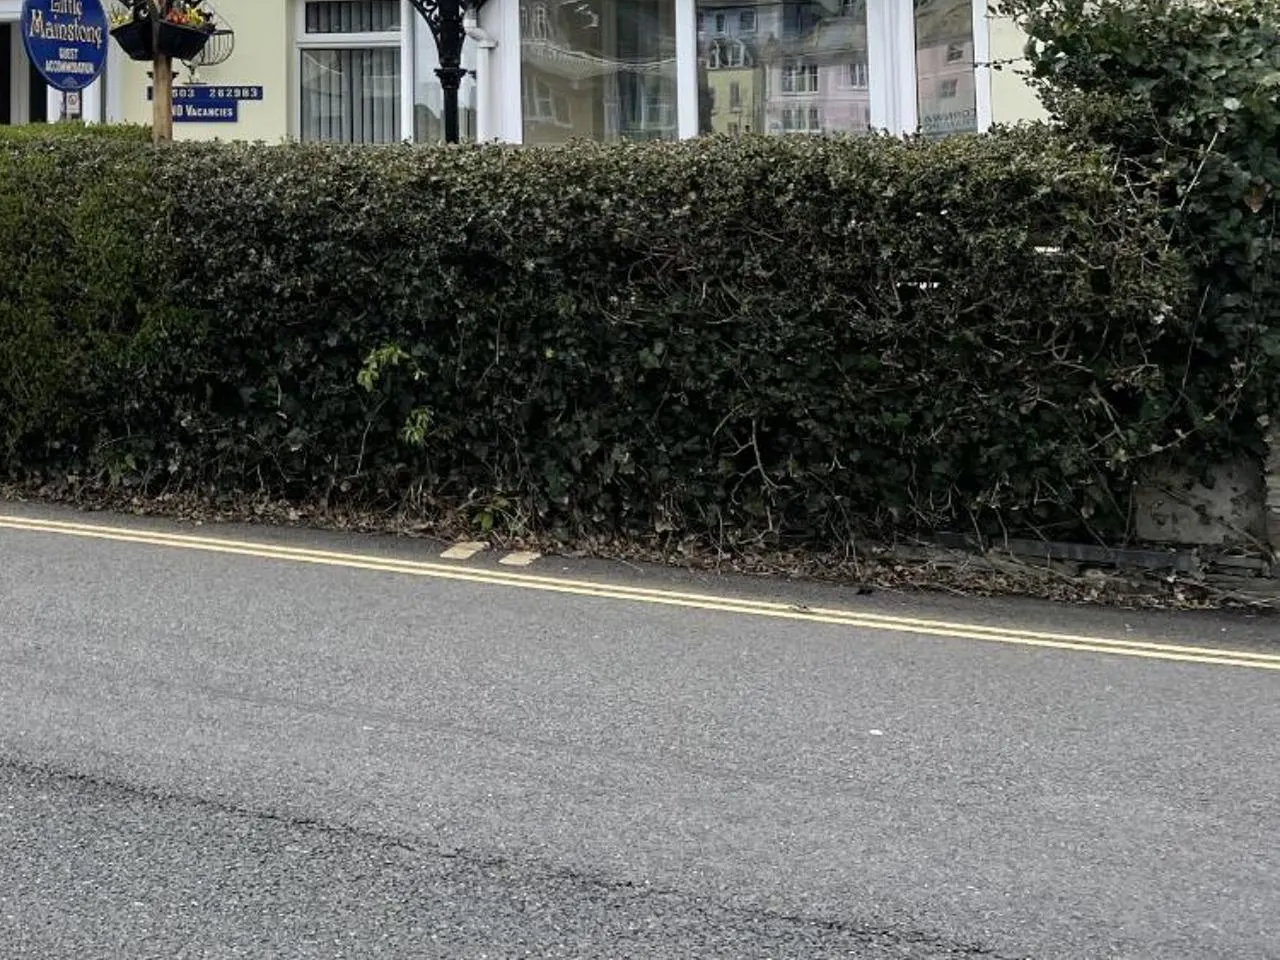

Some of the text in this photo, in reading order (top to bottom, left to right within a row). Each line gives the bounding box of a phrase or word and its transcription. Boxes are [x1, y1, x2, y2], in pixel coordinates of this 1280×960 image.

[29, 9, 103, 49] Mainstone
[58, 47, 79, 60] GUEST
[45, 61, 95, 74] ACCOMMODATION
[209, 87, 258, 98] 262983
